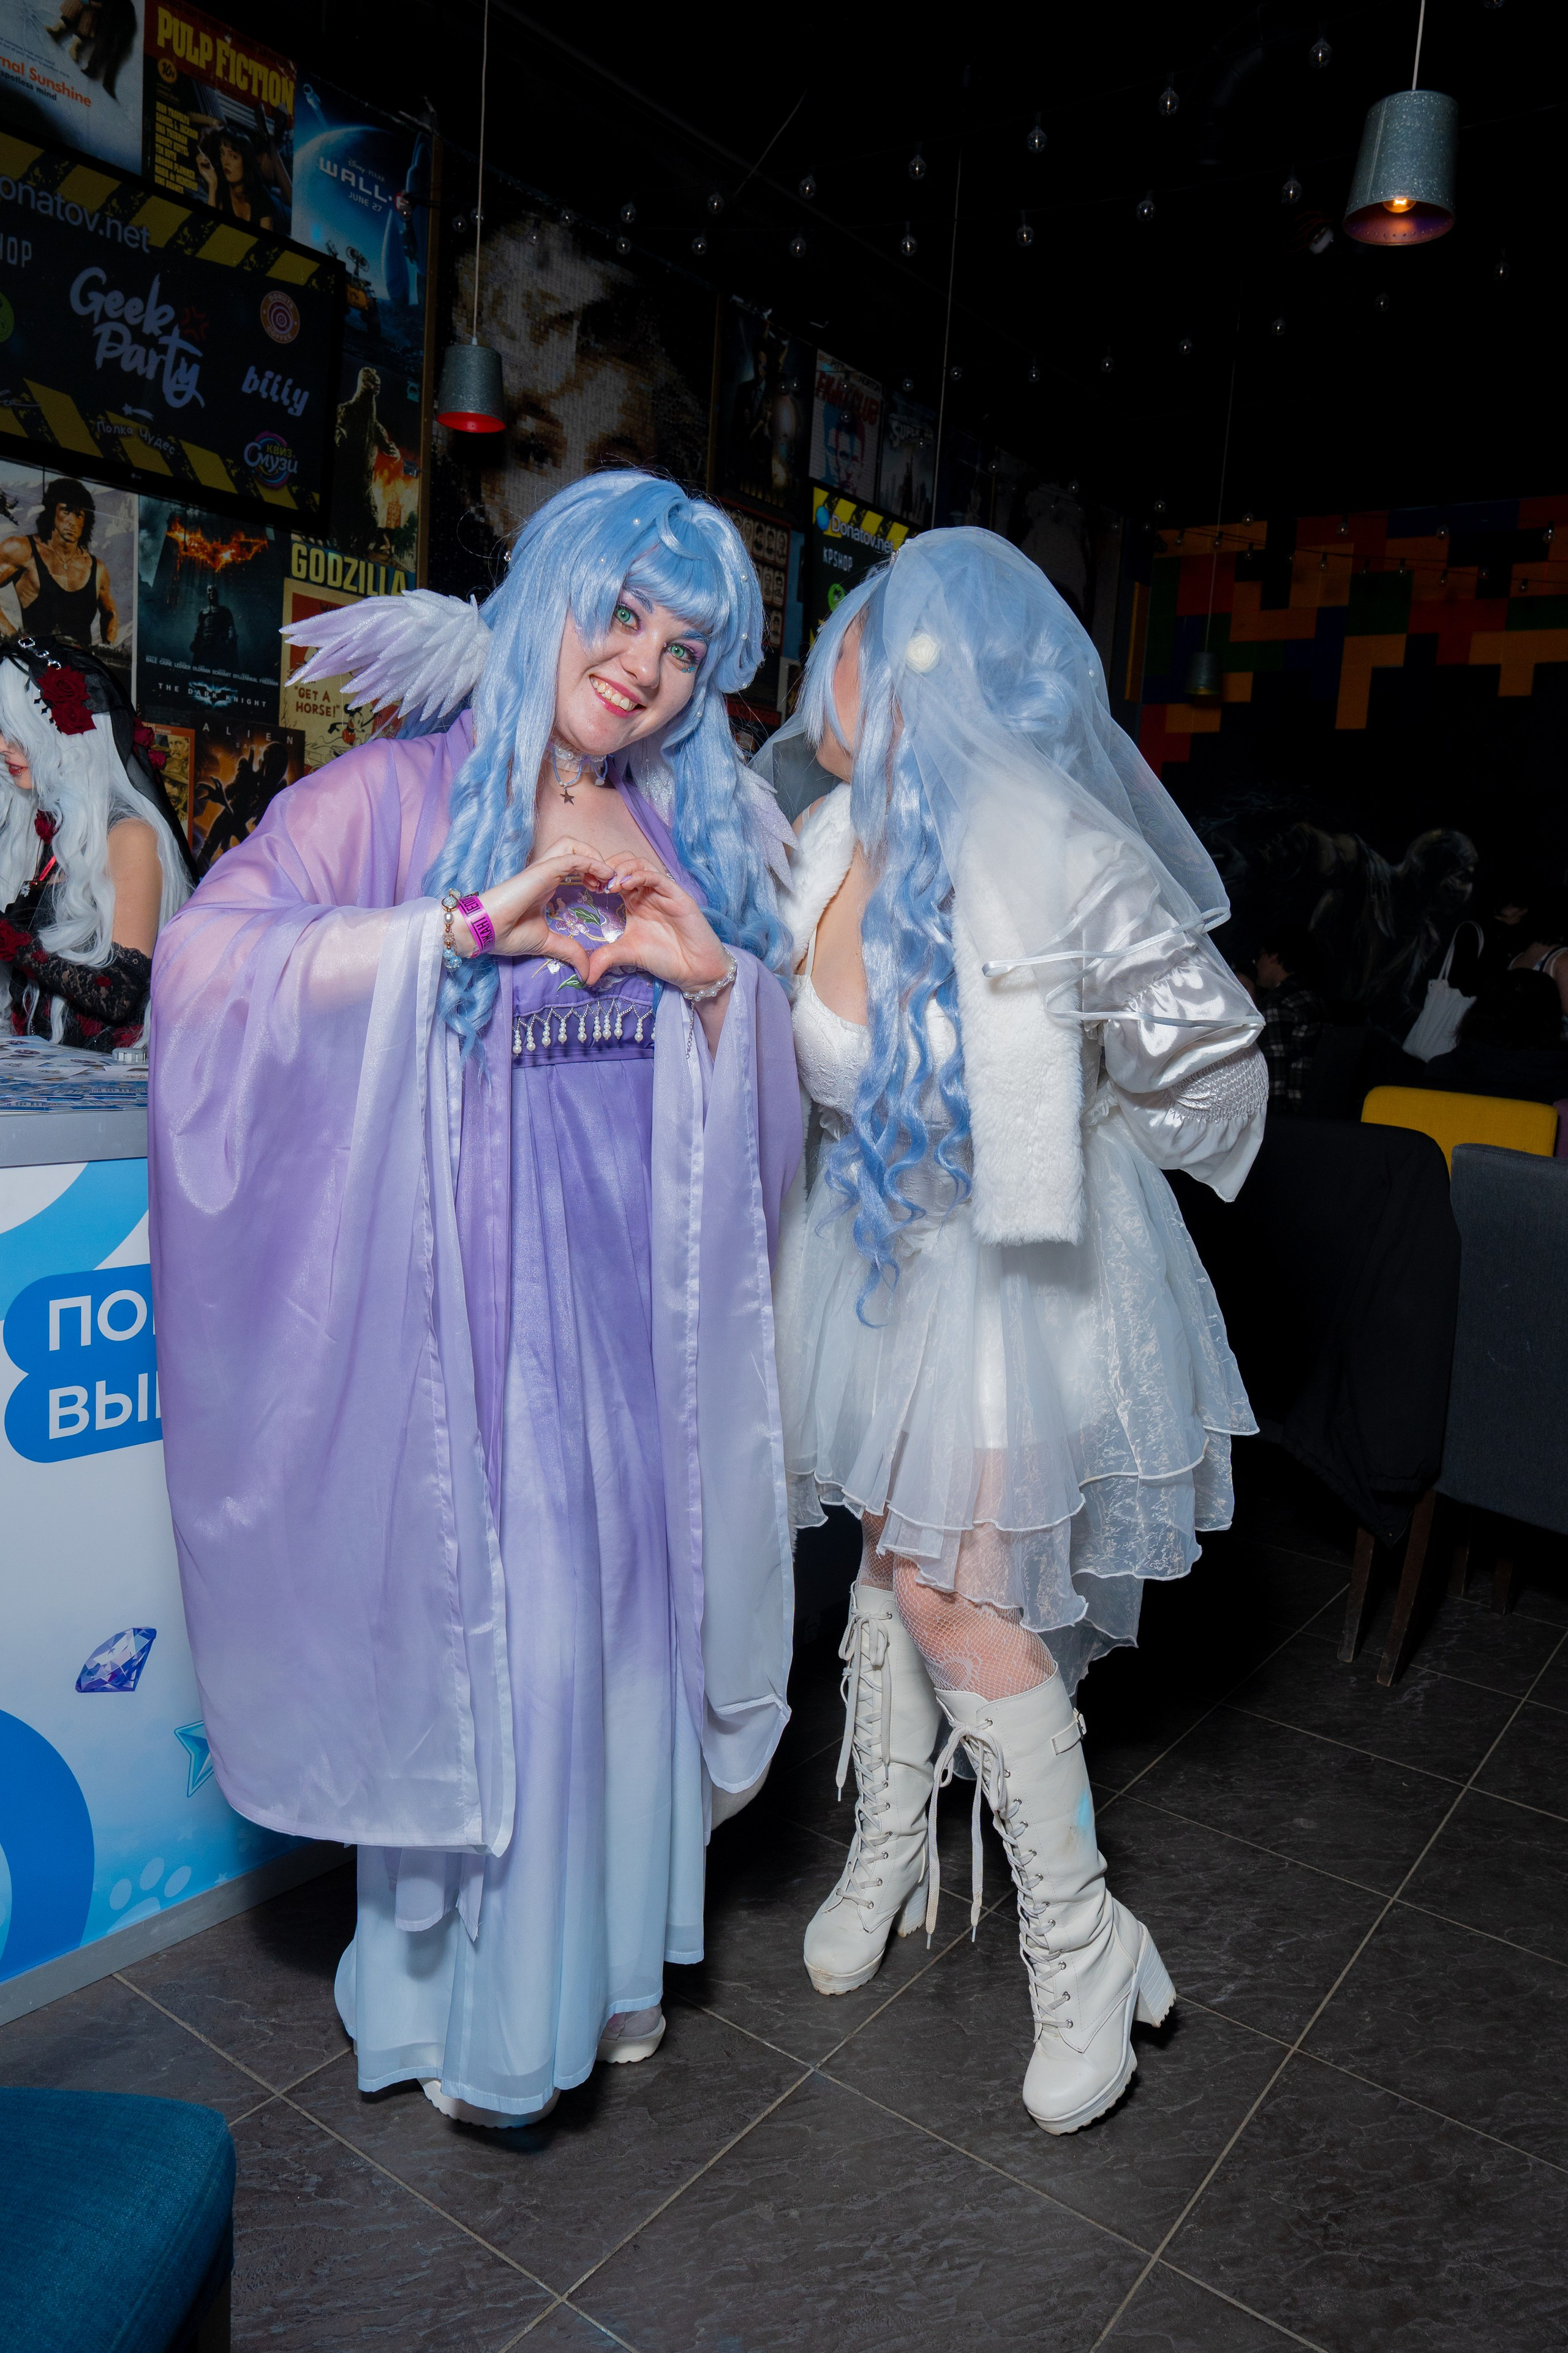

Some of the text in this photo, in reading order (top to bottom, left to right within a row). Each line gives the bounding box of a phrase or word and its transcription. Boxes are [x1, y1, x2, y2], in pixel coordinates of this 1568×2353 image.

[157, 6, 213, 70] PULP
[216, 37, 295, 116] FICTION
[0, 70, 57, 100] spotless mind
[29, 67, 92, 107] Sunshine
[348, 192, 383, 213] JUNE 27
[70, 266, 176, 337] Geek
[268, 293, 293, 309] DONUTS
[266, 326, 293, 341] COFFEE
[92, 321, 206, 409] Party
[241, 365, 309, 417] billy
[96, 420, 175, 455] Полка Чудес
[266, 444, 293, 458] КВИЗ
[244, 442, 299, 474] Смузи
[832, 514, 894, 554] Donatov.net
[292, 542, 407, 596] GODZILLA
[158, 682, 267, 708] THE DARK KNIGHT
[294, 686, 331, 703] "GET A
[296, 701, 340, 718] HORSE!"
[202, 722, 293, 745] ALIEN
[49, 1290, 156, 1351] ПО
[49, 1370, 162, 1440] ВЫ
